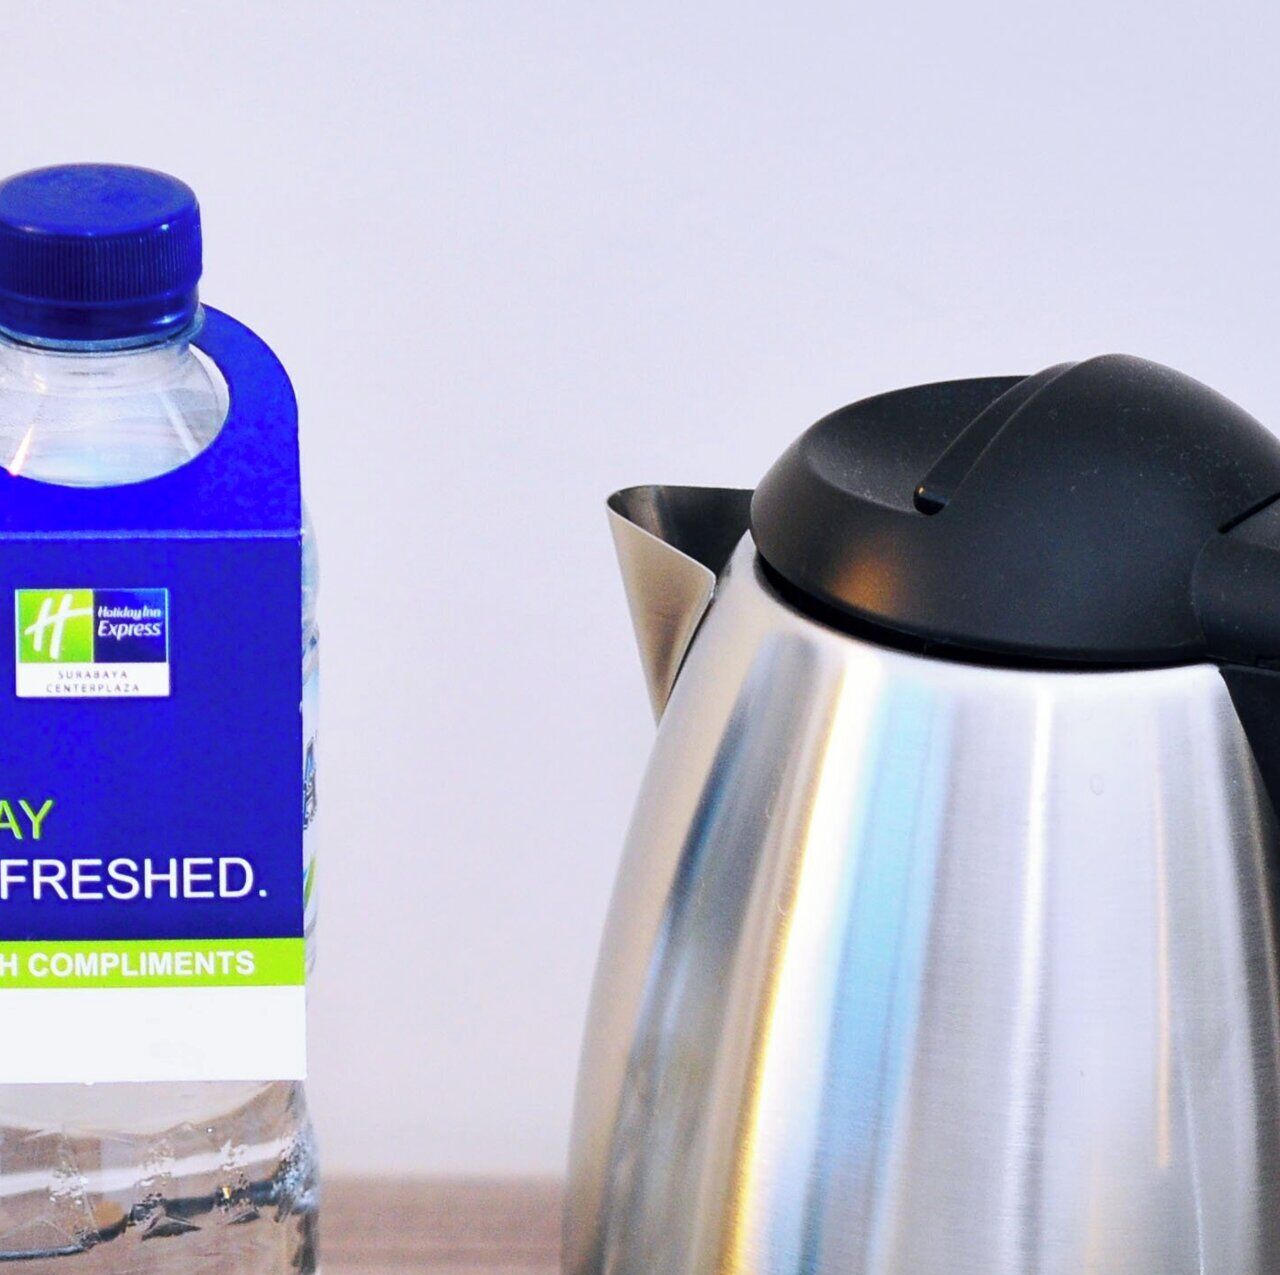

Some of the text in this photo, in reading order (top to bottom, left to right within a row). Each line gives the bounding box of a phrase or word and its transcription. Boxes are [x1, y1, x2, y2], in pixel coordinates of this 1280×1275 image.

[97, 605, 161, 620] Holiday Inn
[97, 620, 162, 641] Express
[58, 670, 128, 679] SURABAYA
[46, 684, 139, 692] CENTERPLAZA
[27, 951, 255, 977] COMPLIMENTS
